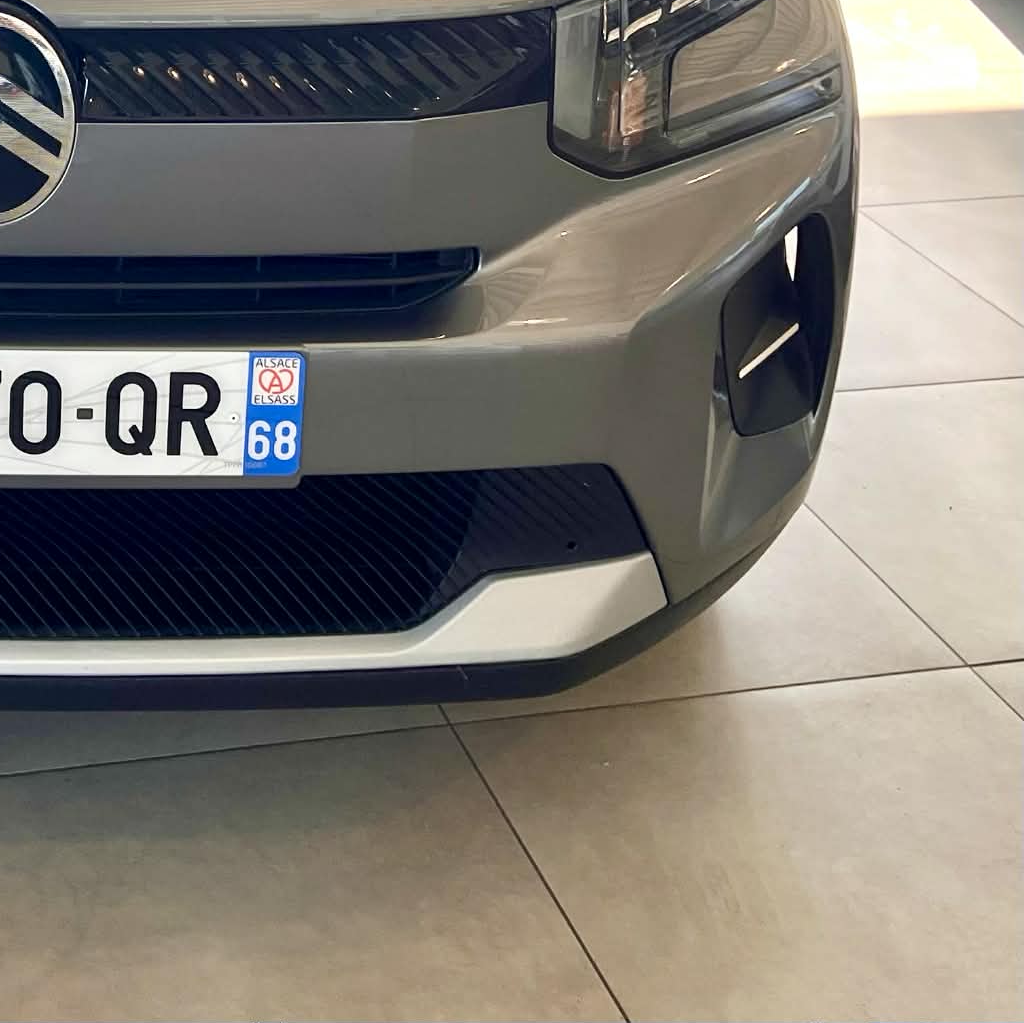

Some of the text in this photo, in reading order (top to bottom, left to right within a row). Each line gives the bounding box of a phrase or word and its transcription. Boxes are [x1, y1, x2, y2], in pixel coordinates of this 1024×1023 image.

[255, 358, 298, 368] ALSACE
[254, 394, 296, 405] ELSASS
[247, 420, 297, 461] 68
